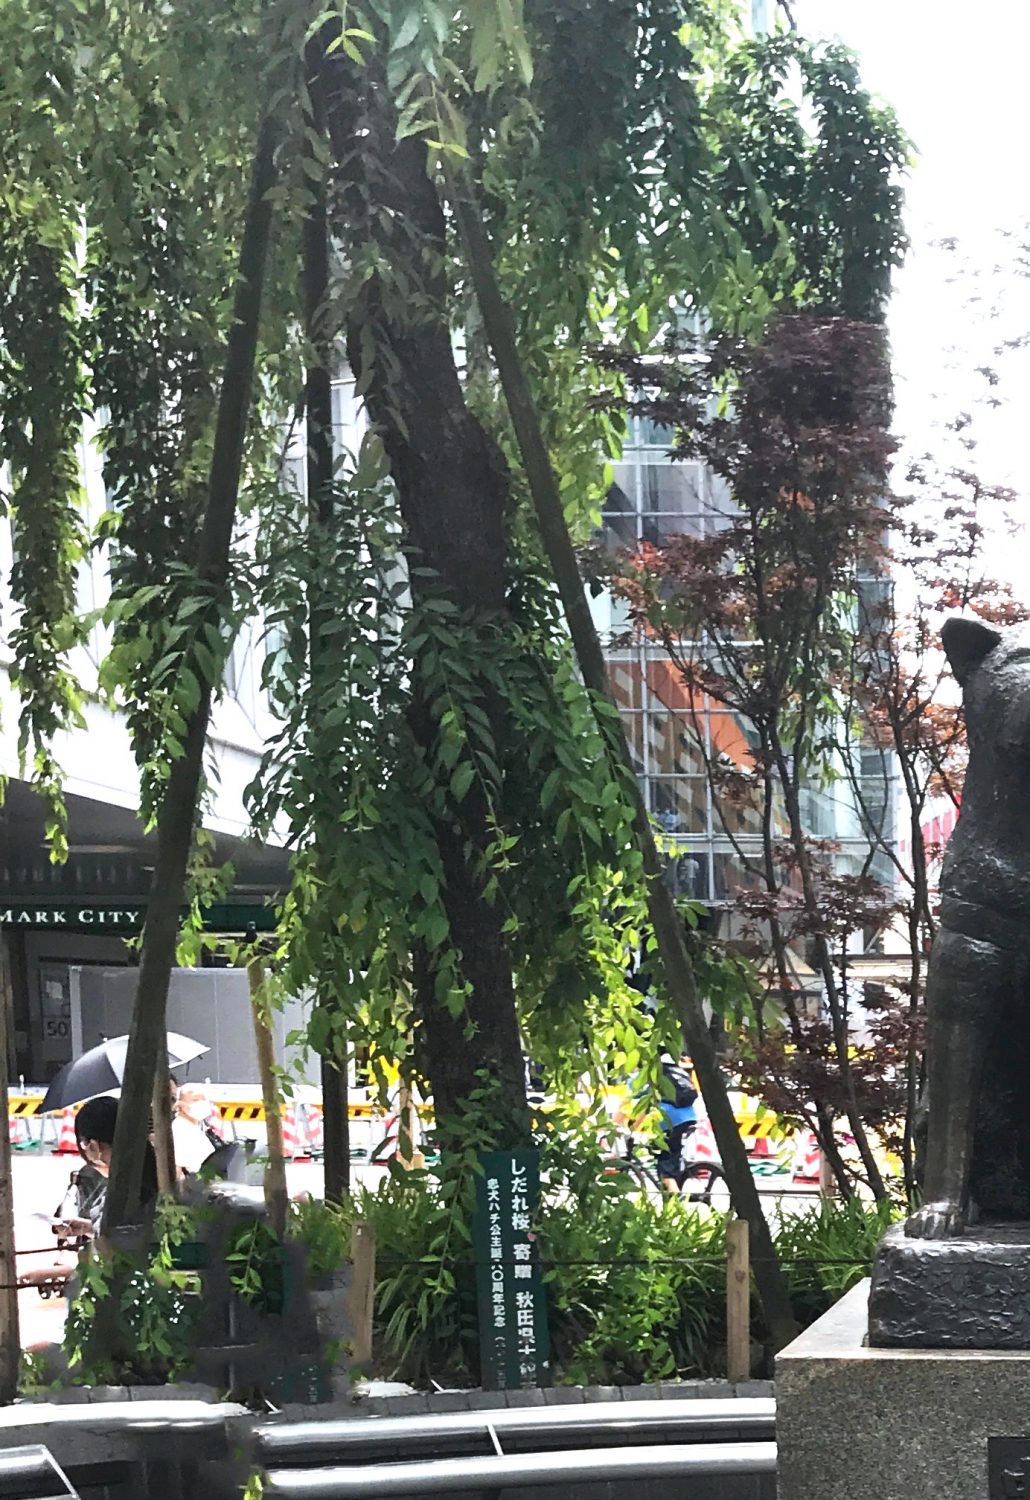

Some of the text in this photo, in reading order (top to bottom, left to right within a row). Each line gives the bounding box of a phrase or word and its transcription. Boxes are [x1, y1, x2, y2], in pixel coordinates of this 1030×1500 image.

[78, 909, 140, 924] CITY
[511, 1158, 531, 1231] しだれ桜
[512, 1243, 533, 1279] 寄贈
